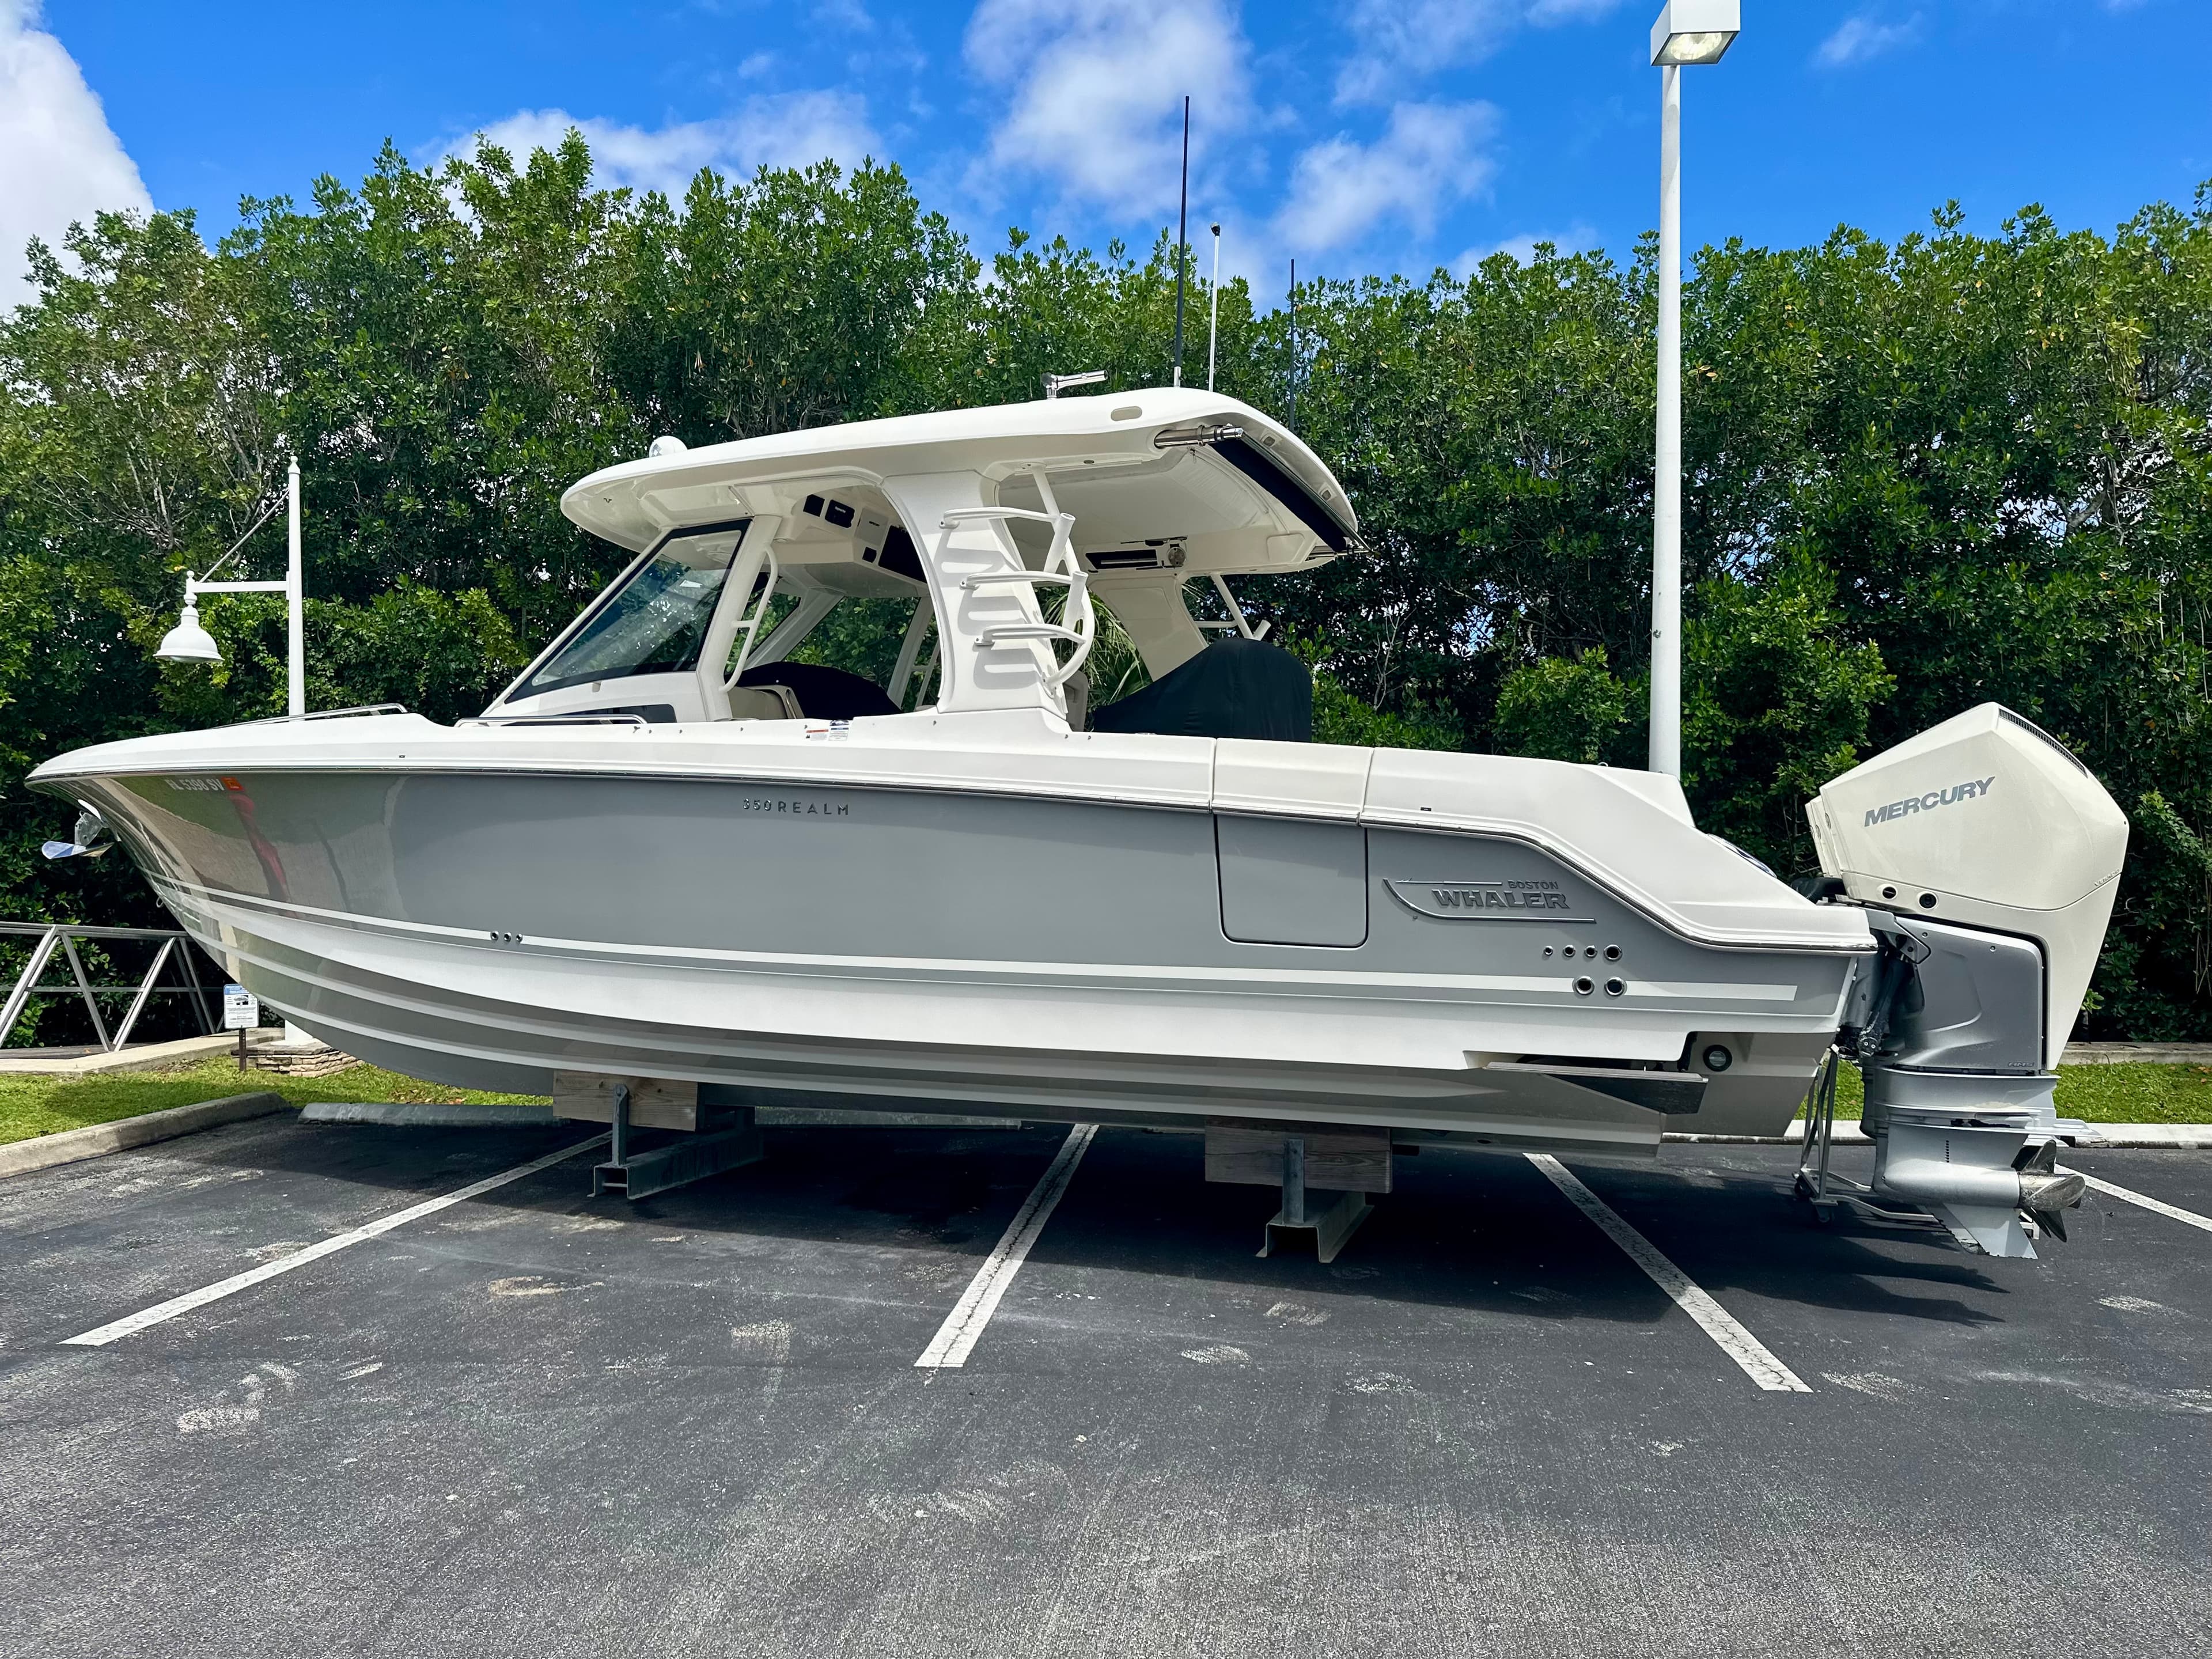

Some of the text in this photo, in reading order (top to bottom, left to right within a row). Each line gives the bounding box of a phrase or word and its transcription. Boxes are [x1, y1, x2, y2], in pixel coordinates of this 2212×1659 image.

[164, 778, 225, 791] FL 5398 SV
[743, 798, 849, 815] 350 REALM
[1864, 776, 1995, 827] MERCURY
[1508, 880, 1559, 890] BOSTON
[1431, 889, 1571, 909] WHALER
